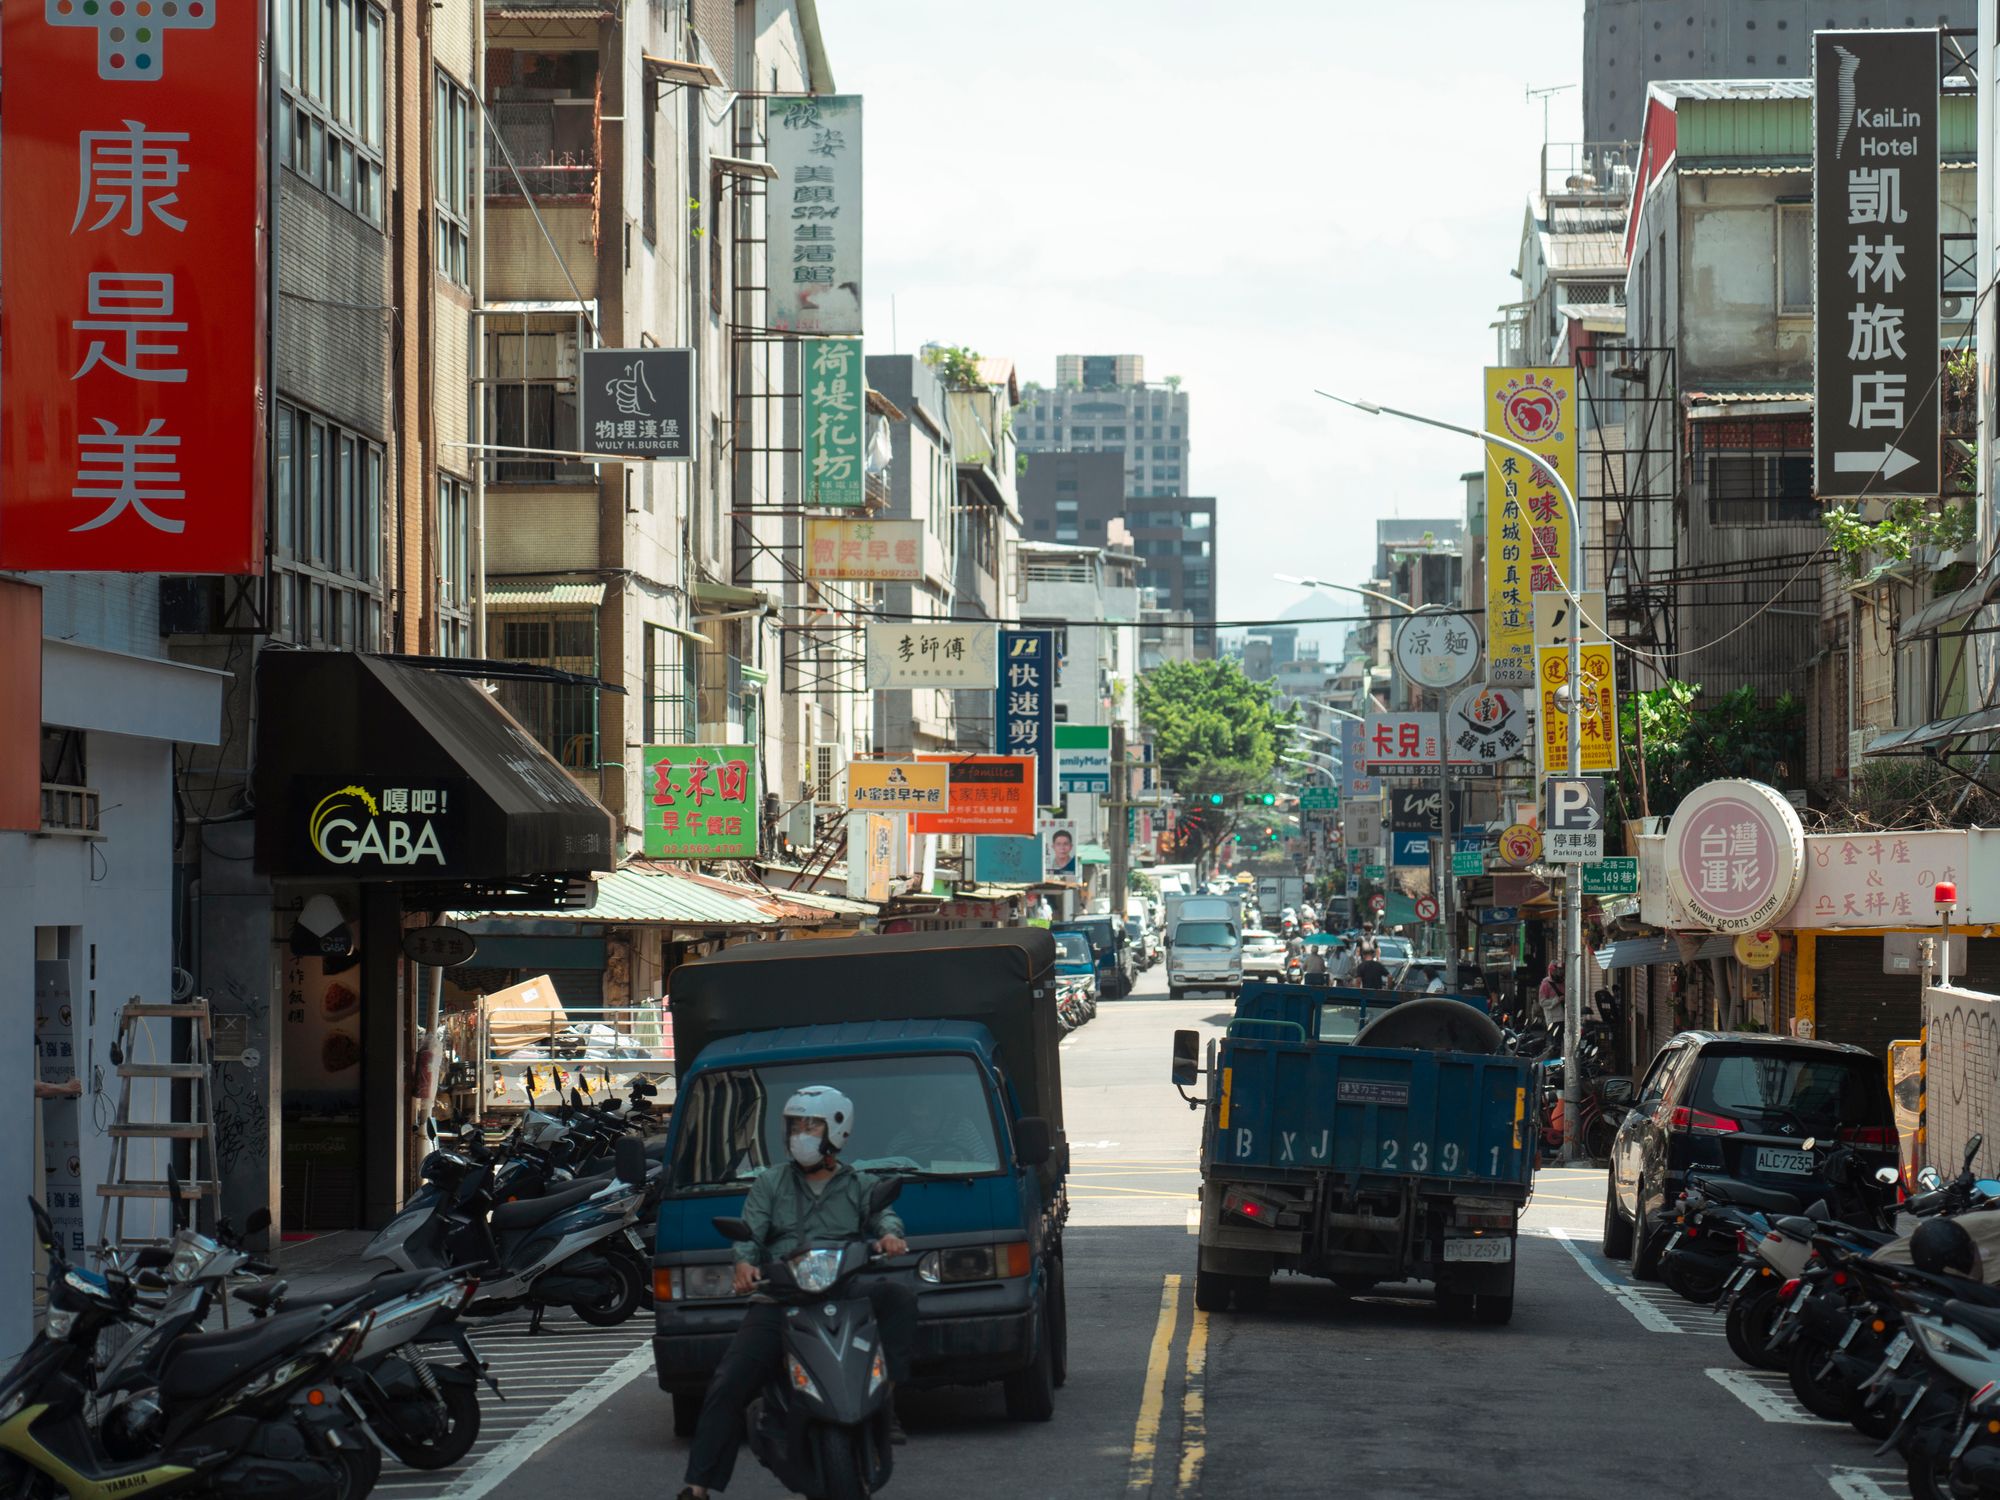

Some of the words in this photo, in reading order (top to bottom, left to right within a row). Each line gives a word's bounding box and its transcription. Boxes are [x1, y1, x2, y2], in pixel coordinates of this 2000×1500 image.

[1857, 108, 1920, 128] KaiLin
[1861, 137, 1918, 156] Hotel
[1847, 167, 1907, 429] 凱林旅店
[69, 119, 190, 534] 康是美
[595, 419, 680, 439] 物理漢堡
[595, 441, 624, 450] WULY
[627, 440, 679, 449] H.BURGER
[813, 539, 918, 564] 微笑早餐
[1502, 456, 1520, 627] 來自府城的真味道
[897, 634, 966, 663] 李師傅
[1409, 629, 1469, 656] 涼麵
[1456, 730, 1520, 759] 鐵板燒
[1059, 756, 1108, 768] amilyMart
[1379, 765, 1484, 776] 預約電話:252-6468
[383, 787, 447, 815] 嘎吧!
[854, 787, 940, 802] 小蜜蜂早午餐
[1554, 781, 1588, 826] P
[662, 810, 742, 837] 早午餐店
[319, 818, 446, 865] GABA
[1553, 832, 1597, 848] 停車場
[1700, 821, 1758, 857] 台灣
[1840, 839, 1911, 865] 金牛座
[1553, 849, 1582, 858] Parking
[1585, 848, 1597, 857] Lot
[1585, 860, 1635, 869] 新生北路二段
[1602, 872, 1619, 883] 149
[1620, 871, 1633, 883] 巷
[1700, 859, 1761, 893] 運彩
[1866, 870, 1883, 886] &
[1687, 898, 1716, 925] TAIWAN
[1716, 917, 1749, 929] SPORTS
[1750, 894, 1779, 923] LOTTERY
[1842, 891, 1913, 917] 天秤座
[106, 1474, 148, 1495] YAMAHA
